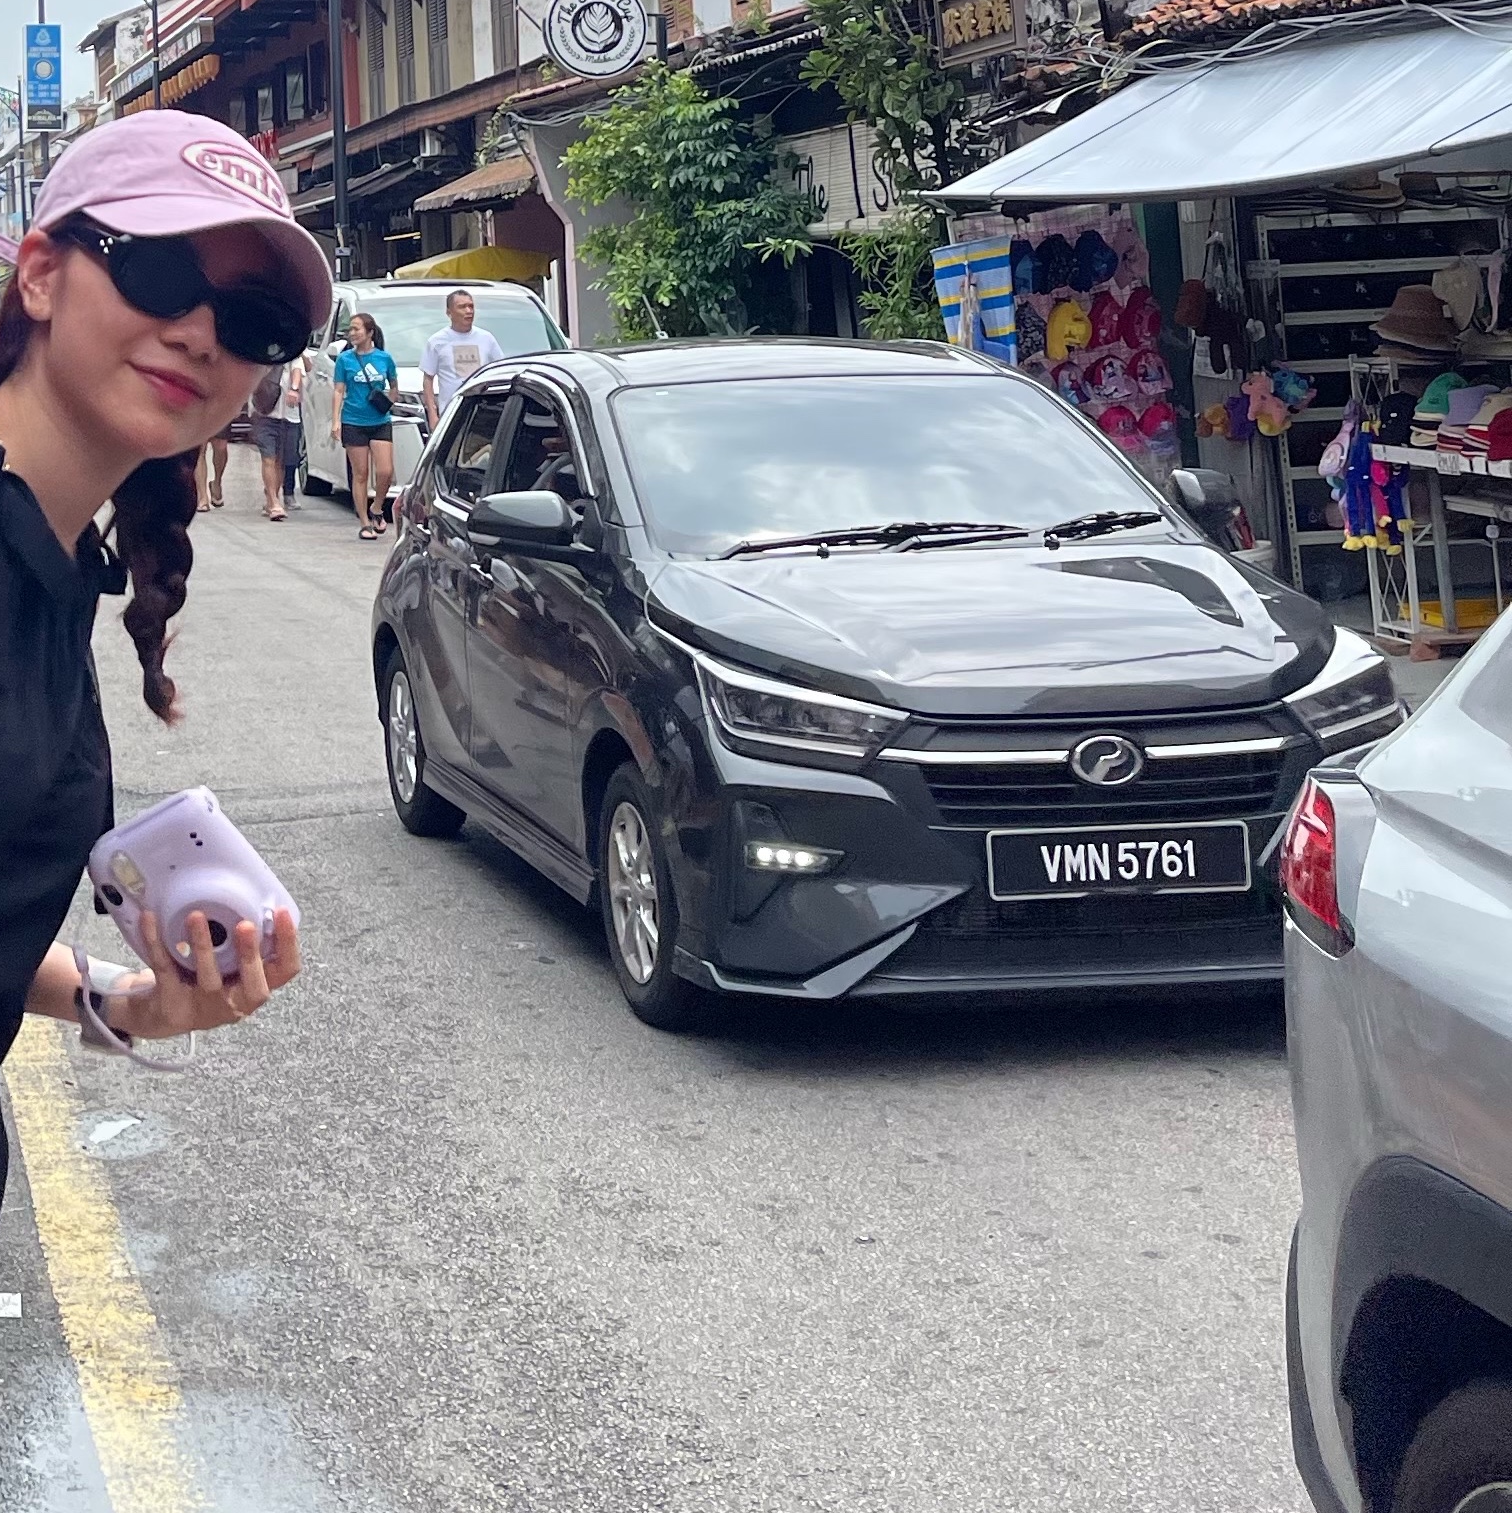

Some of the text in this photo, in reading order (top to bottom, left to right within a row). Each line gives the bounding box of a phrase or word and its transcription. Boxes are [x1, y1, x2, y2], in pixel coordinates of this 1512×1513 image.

[557, 2, 578, 24] The
[1040, 839, 1197, 882] VMN 5761
